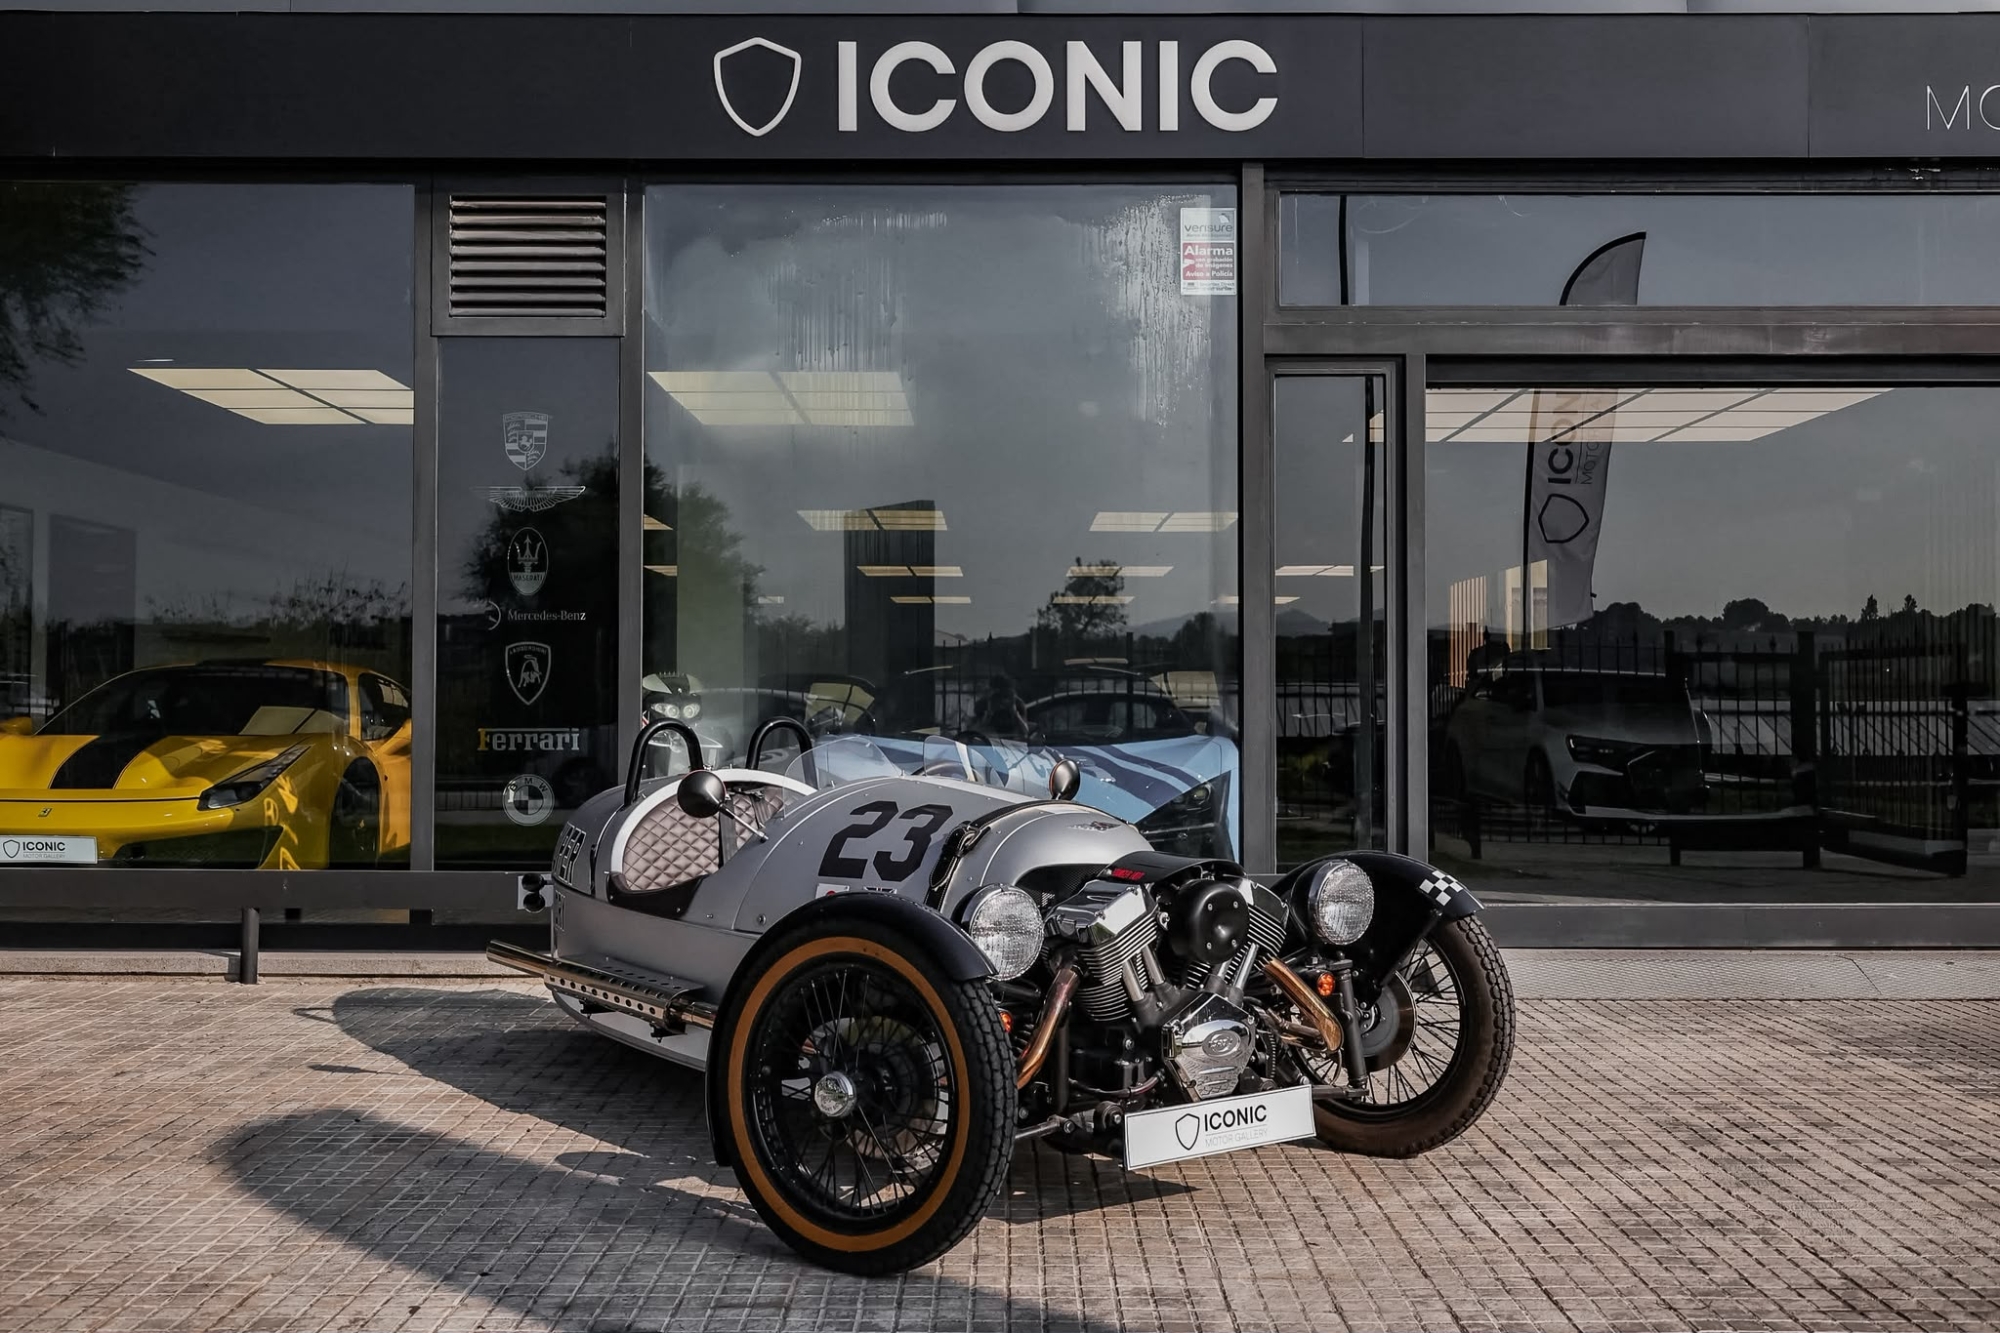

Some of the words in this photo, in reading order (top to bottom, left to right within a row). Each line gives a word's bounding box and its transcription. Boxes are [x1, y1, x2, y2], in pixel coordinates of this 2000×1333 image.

[838, 39, 1278, 133] ICONIC
[1184, 224, 1233, 233] verisure
[1184, 245, 1233, 256] Alarma
[507, 609, 586, 620] Mercedes-Benz
[477, 727, 580, 751] Ferrari
[509, 777, 549, 793] BMW
[22, 841, 66, 852] ICONIC
[818, 800, 954, 882] 23
[1204, 1104, 1268, 1132] ICONIC
[1205, 1135, 1234, 1148] MOTOR
[1235, 1128, 1268, 1143] GALLERY
